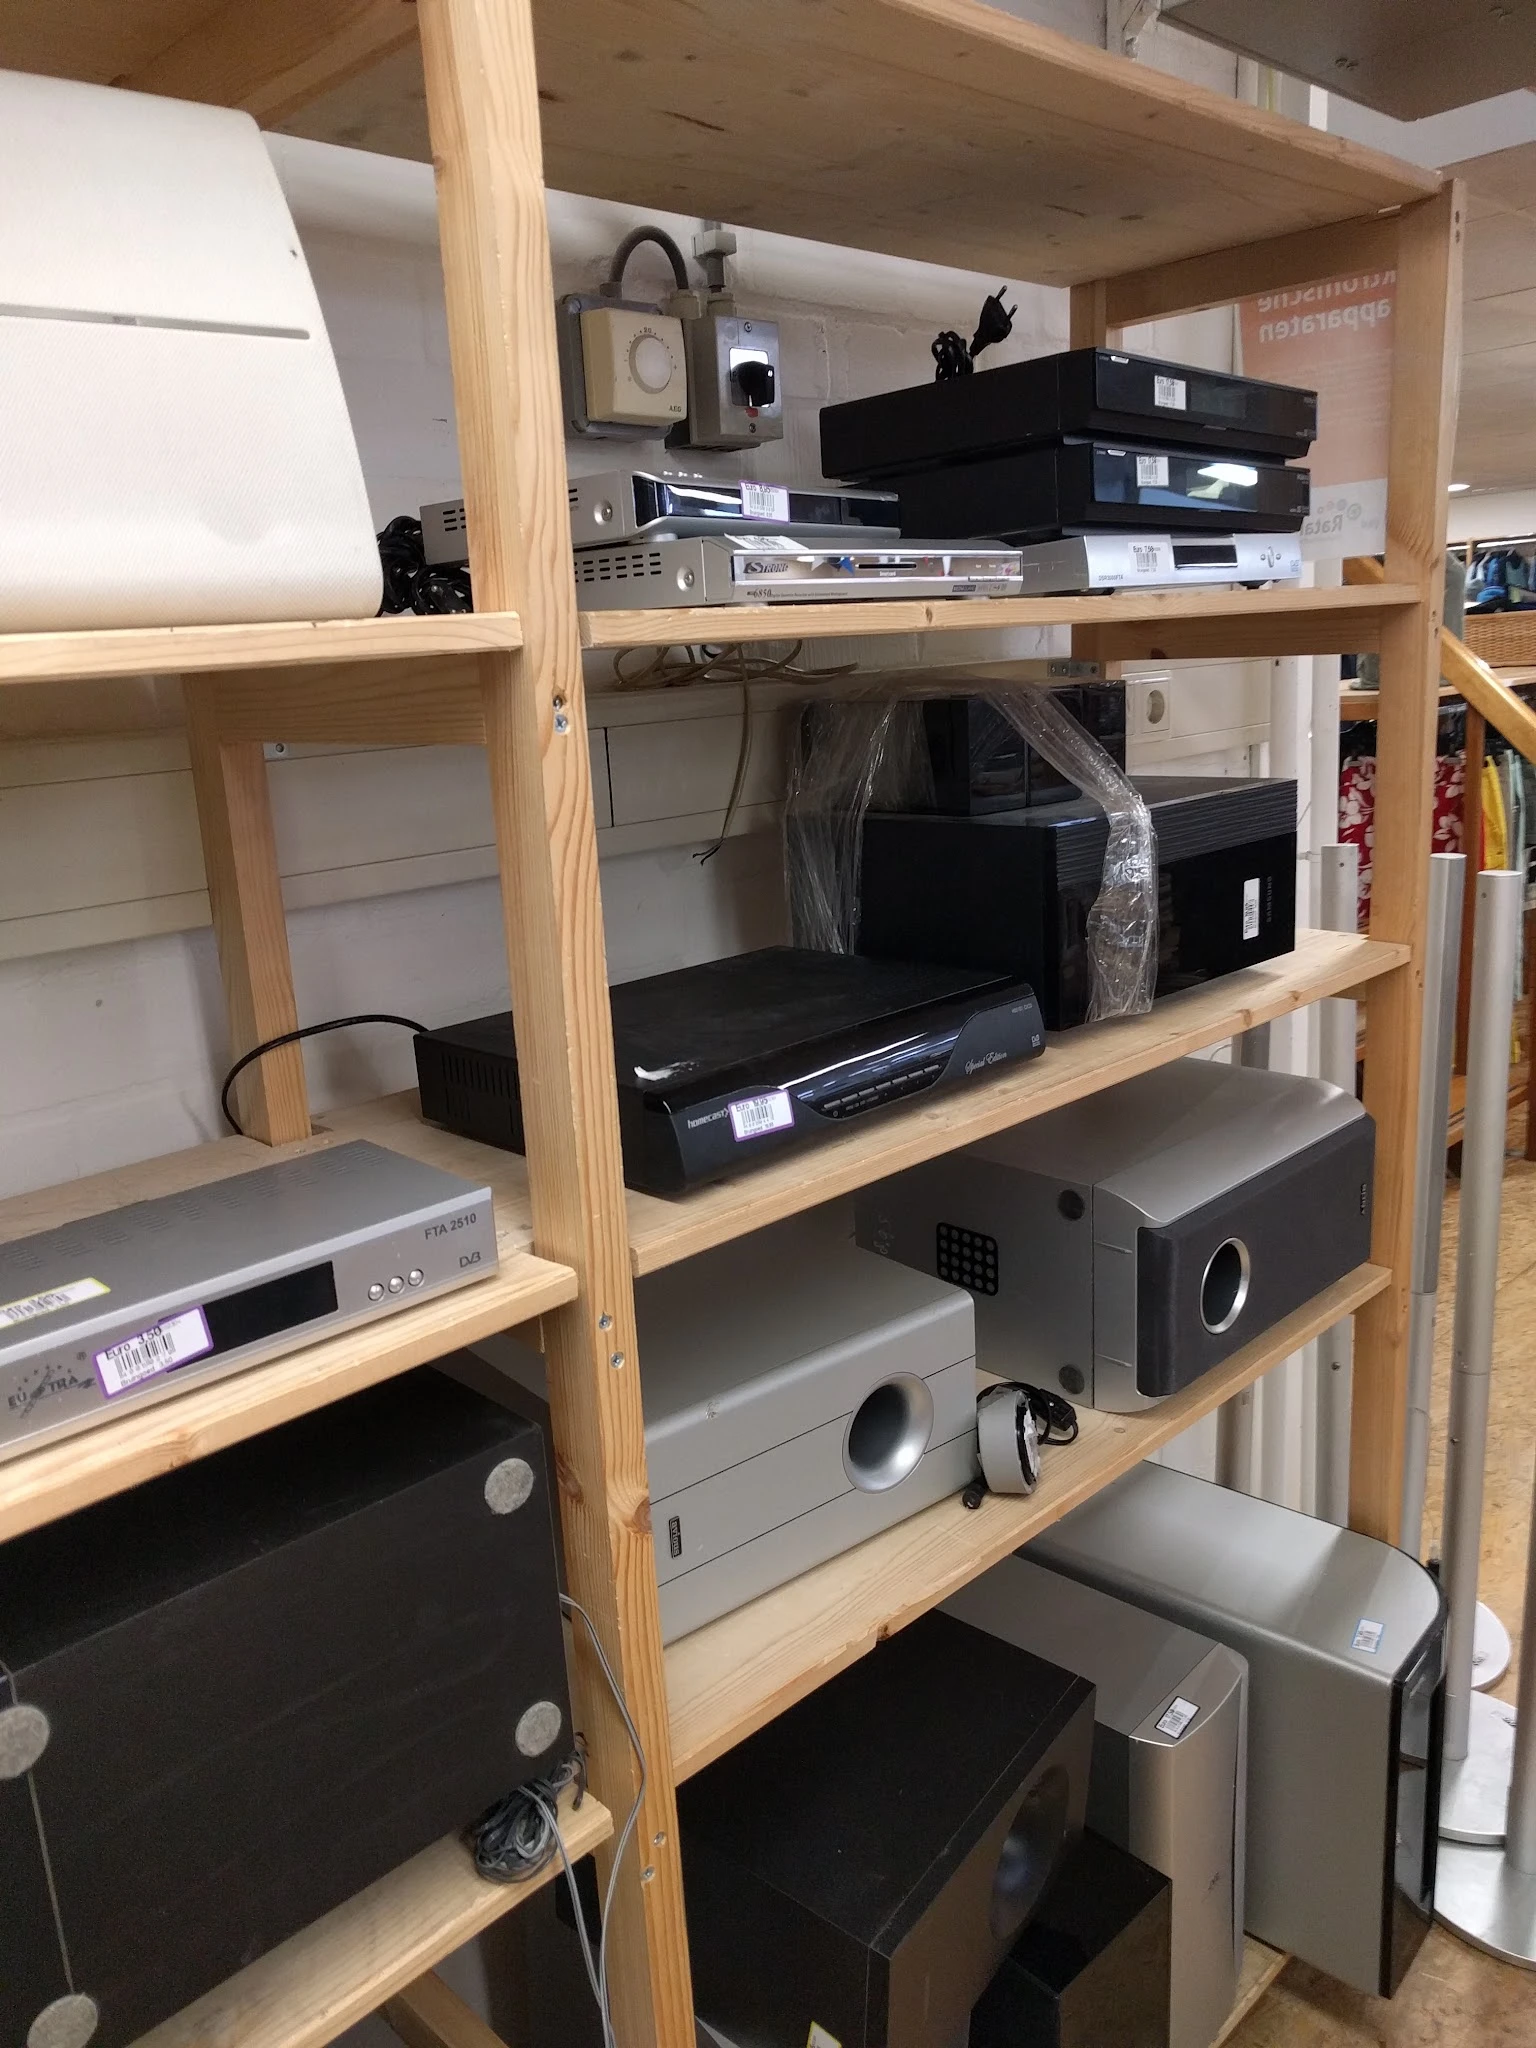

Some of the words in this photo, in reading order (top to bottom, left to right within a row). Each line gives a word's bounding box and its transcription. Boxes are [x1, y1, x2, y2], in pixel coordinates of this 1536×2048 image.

[668, 405, 682, 413] AEG
[965, 1056, 986, 1075] Special
[986, 1051, 1007, 1065] Edition
[735, 1102, 750, 1112] Euro
[687, 1110, 724, 1129] homecast
[424, 1223, 448, 1240] FTA
[450, 1212, 477, 1231] 2510
[459, 1251, 481, 1268] DVB
[105, 1343, 131, 1361] Euro
[138, 1326, 162, 1345] 3,50
